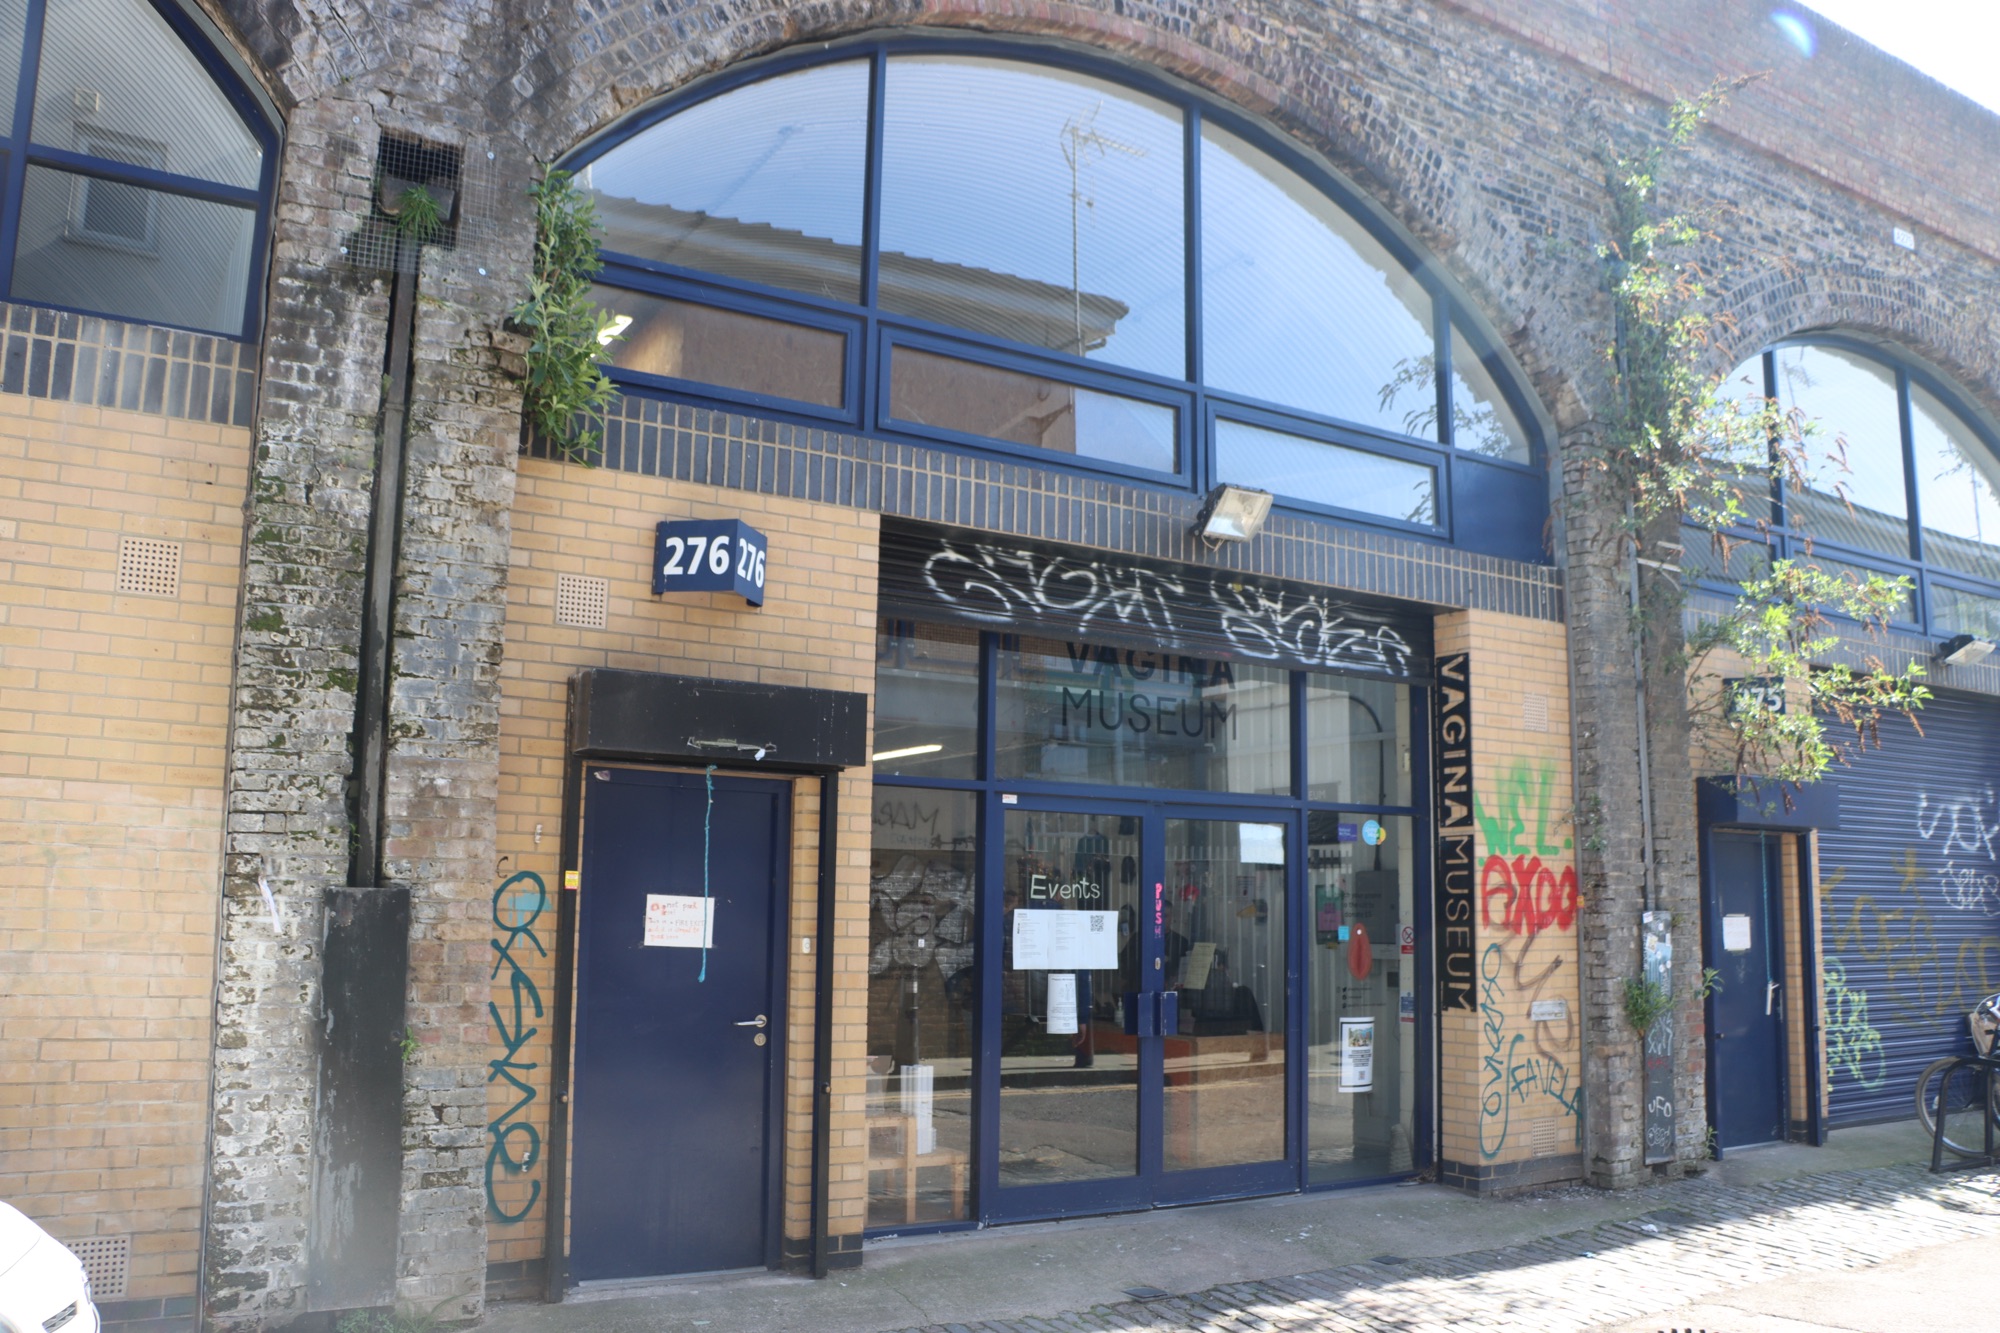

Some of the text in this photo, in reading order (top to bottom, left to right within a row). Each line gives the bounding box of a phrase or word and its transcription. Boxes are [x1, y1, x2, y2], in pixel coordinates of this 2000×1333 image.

[663, 536, 730, 575] 276
[737, 538, 766, 588] 276
[1067, 642, 1236, 690] VAGINA
[1062, 687, 1237, 740] MUSEUM
[1441, 655, 1468, 826] VAGINA
[1030, 874, 1101, 899] Events
[1445, 836, 1471, 1012] MUSEUM
